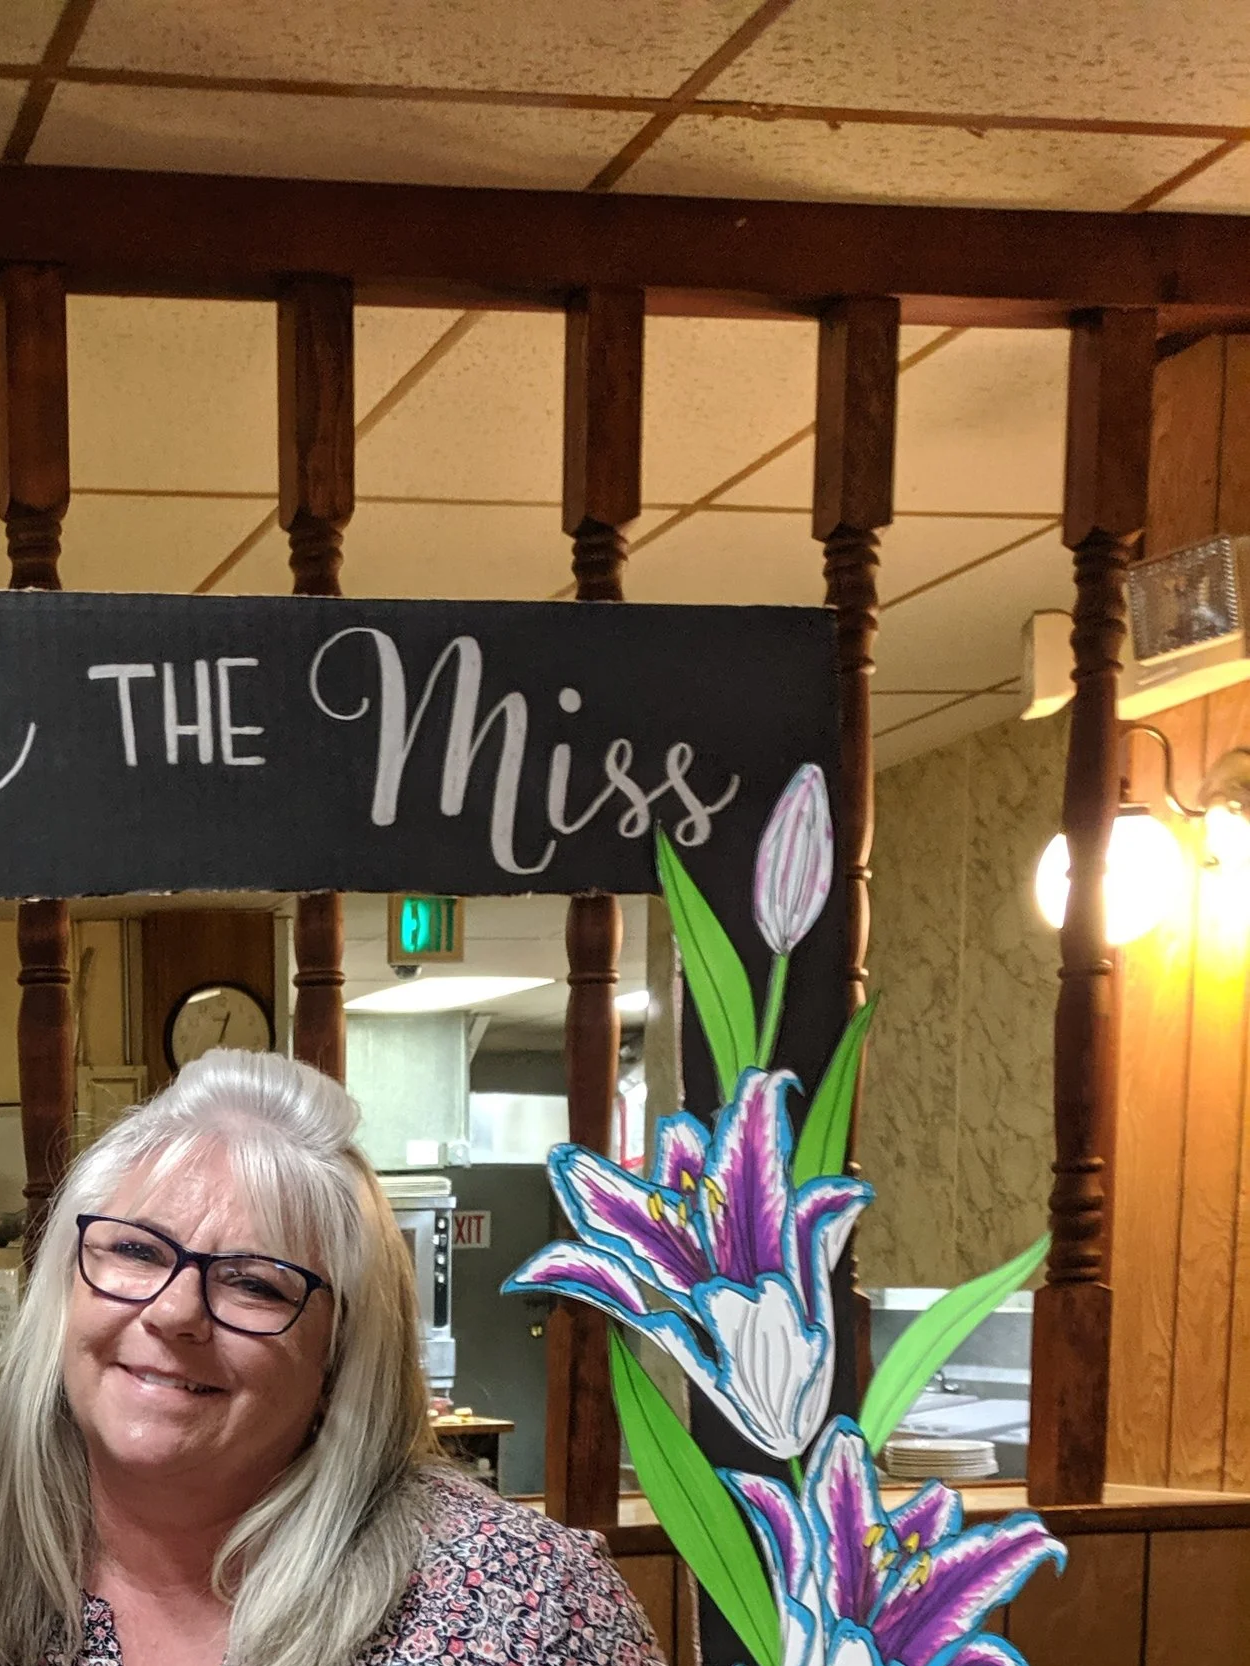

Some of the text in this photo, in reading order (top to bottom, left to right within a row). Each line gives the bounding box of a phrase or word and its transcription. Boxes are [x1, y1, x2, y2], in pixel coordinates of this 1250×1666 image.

[87, 656, 266, 767] THE
[309, 626, 741, 875] Miss
[453, 1215, 485, 1245] XIT
